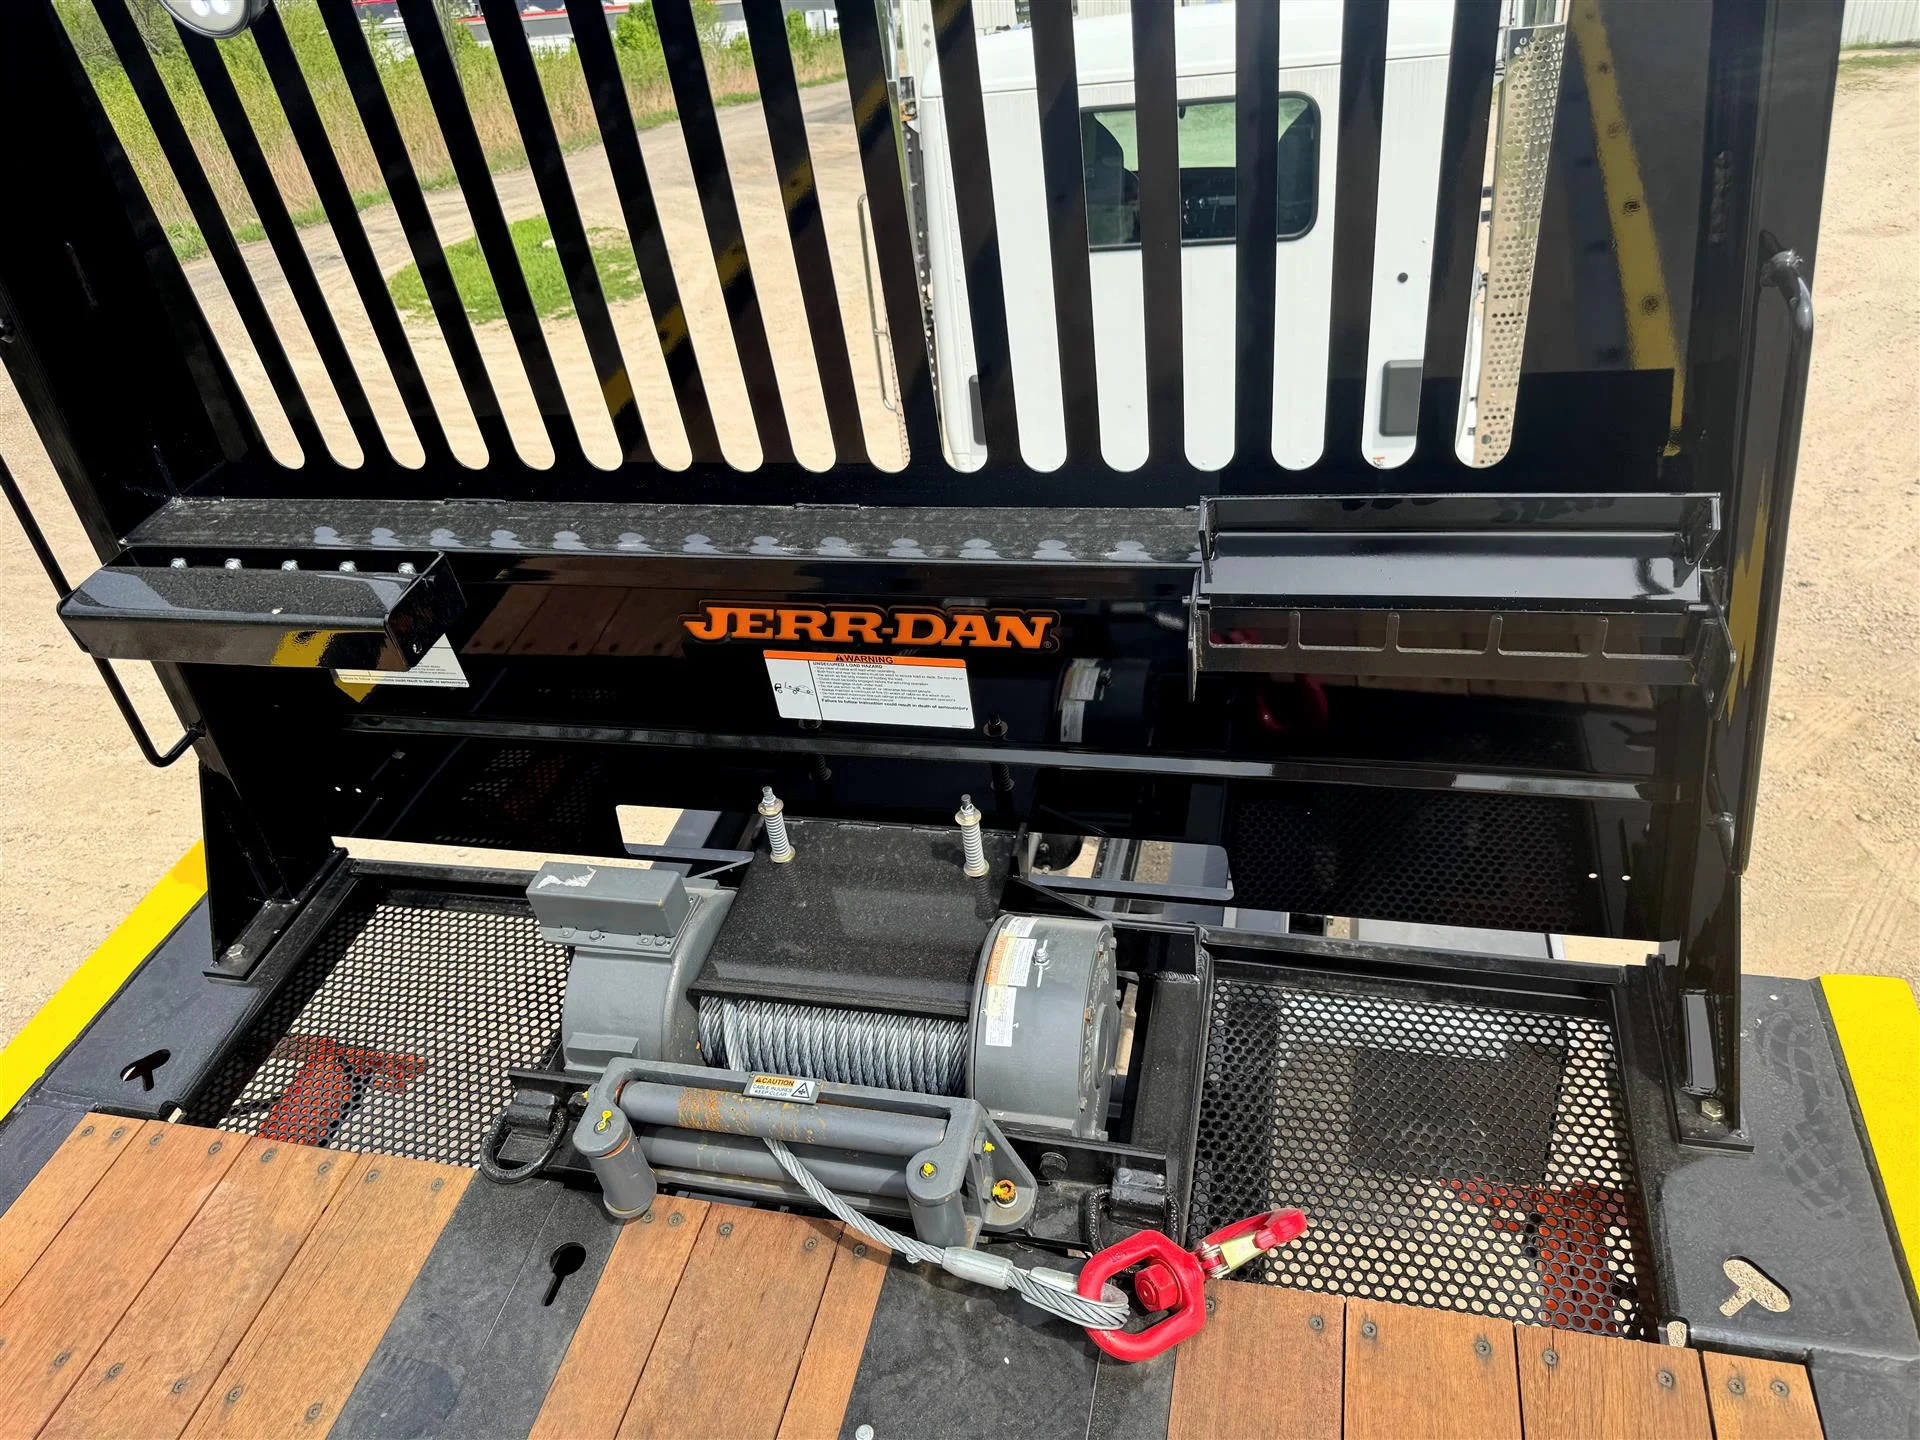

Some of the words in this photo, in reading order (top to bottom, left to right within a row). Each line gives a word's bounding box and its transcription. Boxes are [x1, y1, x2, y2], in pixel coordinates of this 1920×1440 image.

[683, 606, 1052, 649] JERR-DAN
[844, 654, 894, 664] WARNING
[761, 1077, 795, 1087] CAUTION
